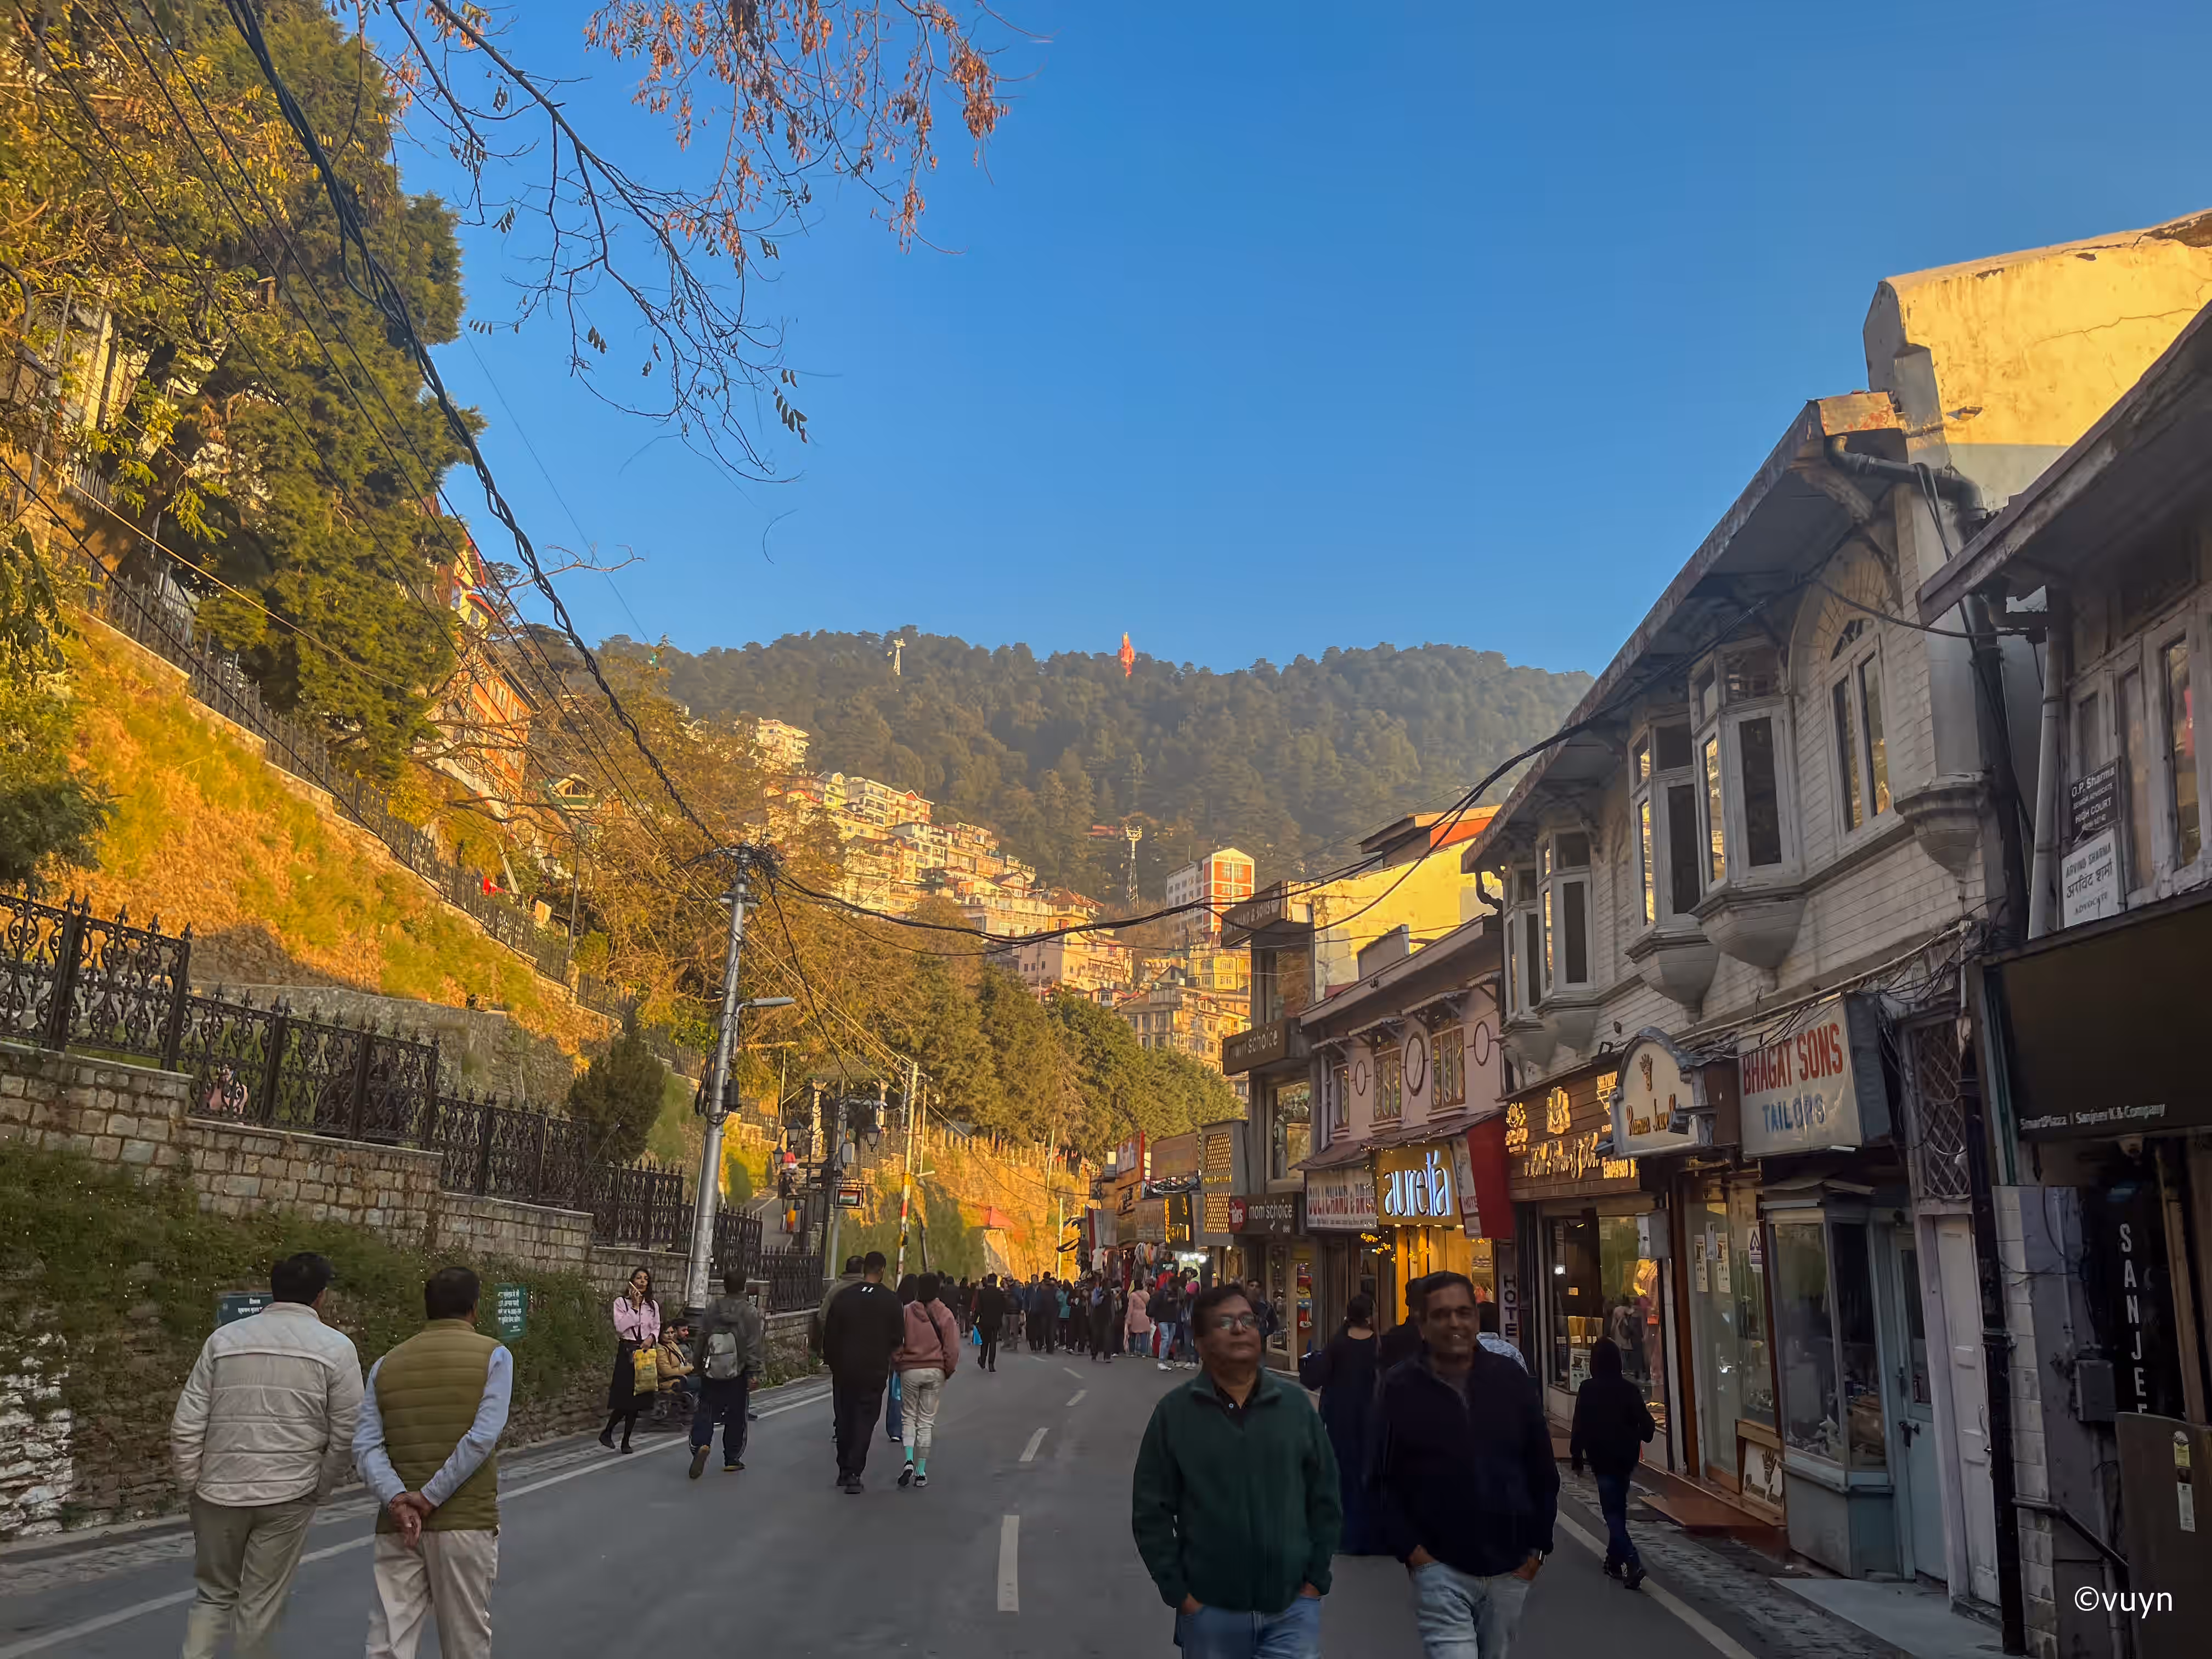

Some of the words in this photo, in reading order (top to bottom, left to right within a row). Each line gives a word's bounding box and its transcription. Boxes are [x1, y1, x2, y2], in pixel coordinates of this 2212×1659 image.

[2086, 766, 2115, 789] Sharma
[2091, 797, 2112, 815] COURT
[2089, 842, 2112, 865] SHARMA
[2074, 891, 2108, 916] ADVOCATE
[1742, 1039, 1792, 1097] BHAGAT
[1796, 1022, 1843, 1081] SONS
[1762, 1093, 1826, 1133] TAILORS
[1504, 1274, 1518, 1344] HOTE
